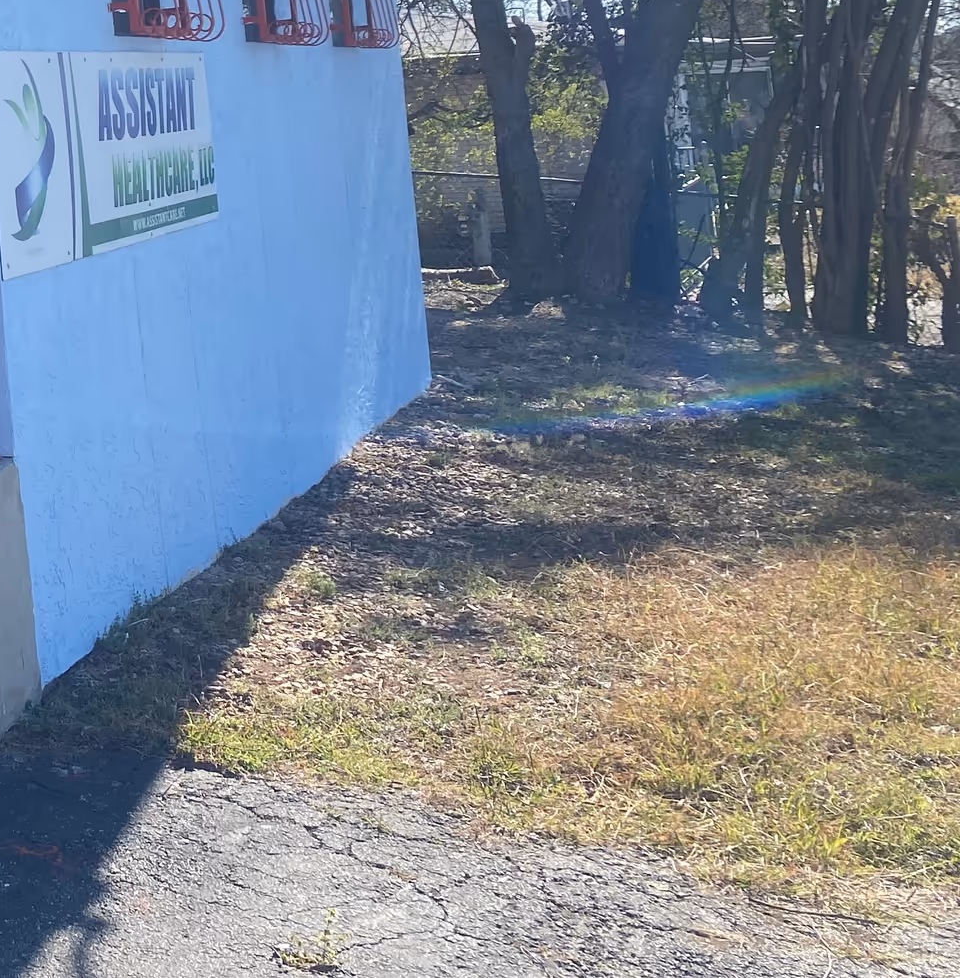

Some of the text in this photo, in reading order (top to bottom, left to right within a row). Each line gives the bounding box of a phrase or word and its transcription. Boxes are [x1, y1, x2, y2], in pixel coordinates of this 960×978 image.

[98, 67, 196, 142] ASSISTANT
[112, 143, 215, 208] HEALTHCARE, LLC
